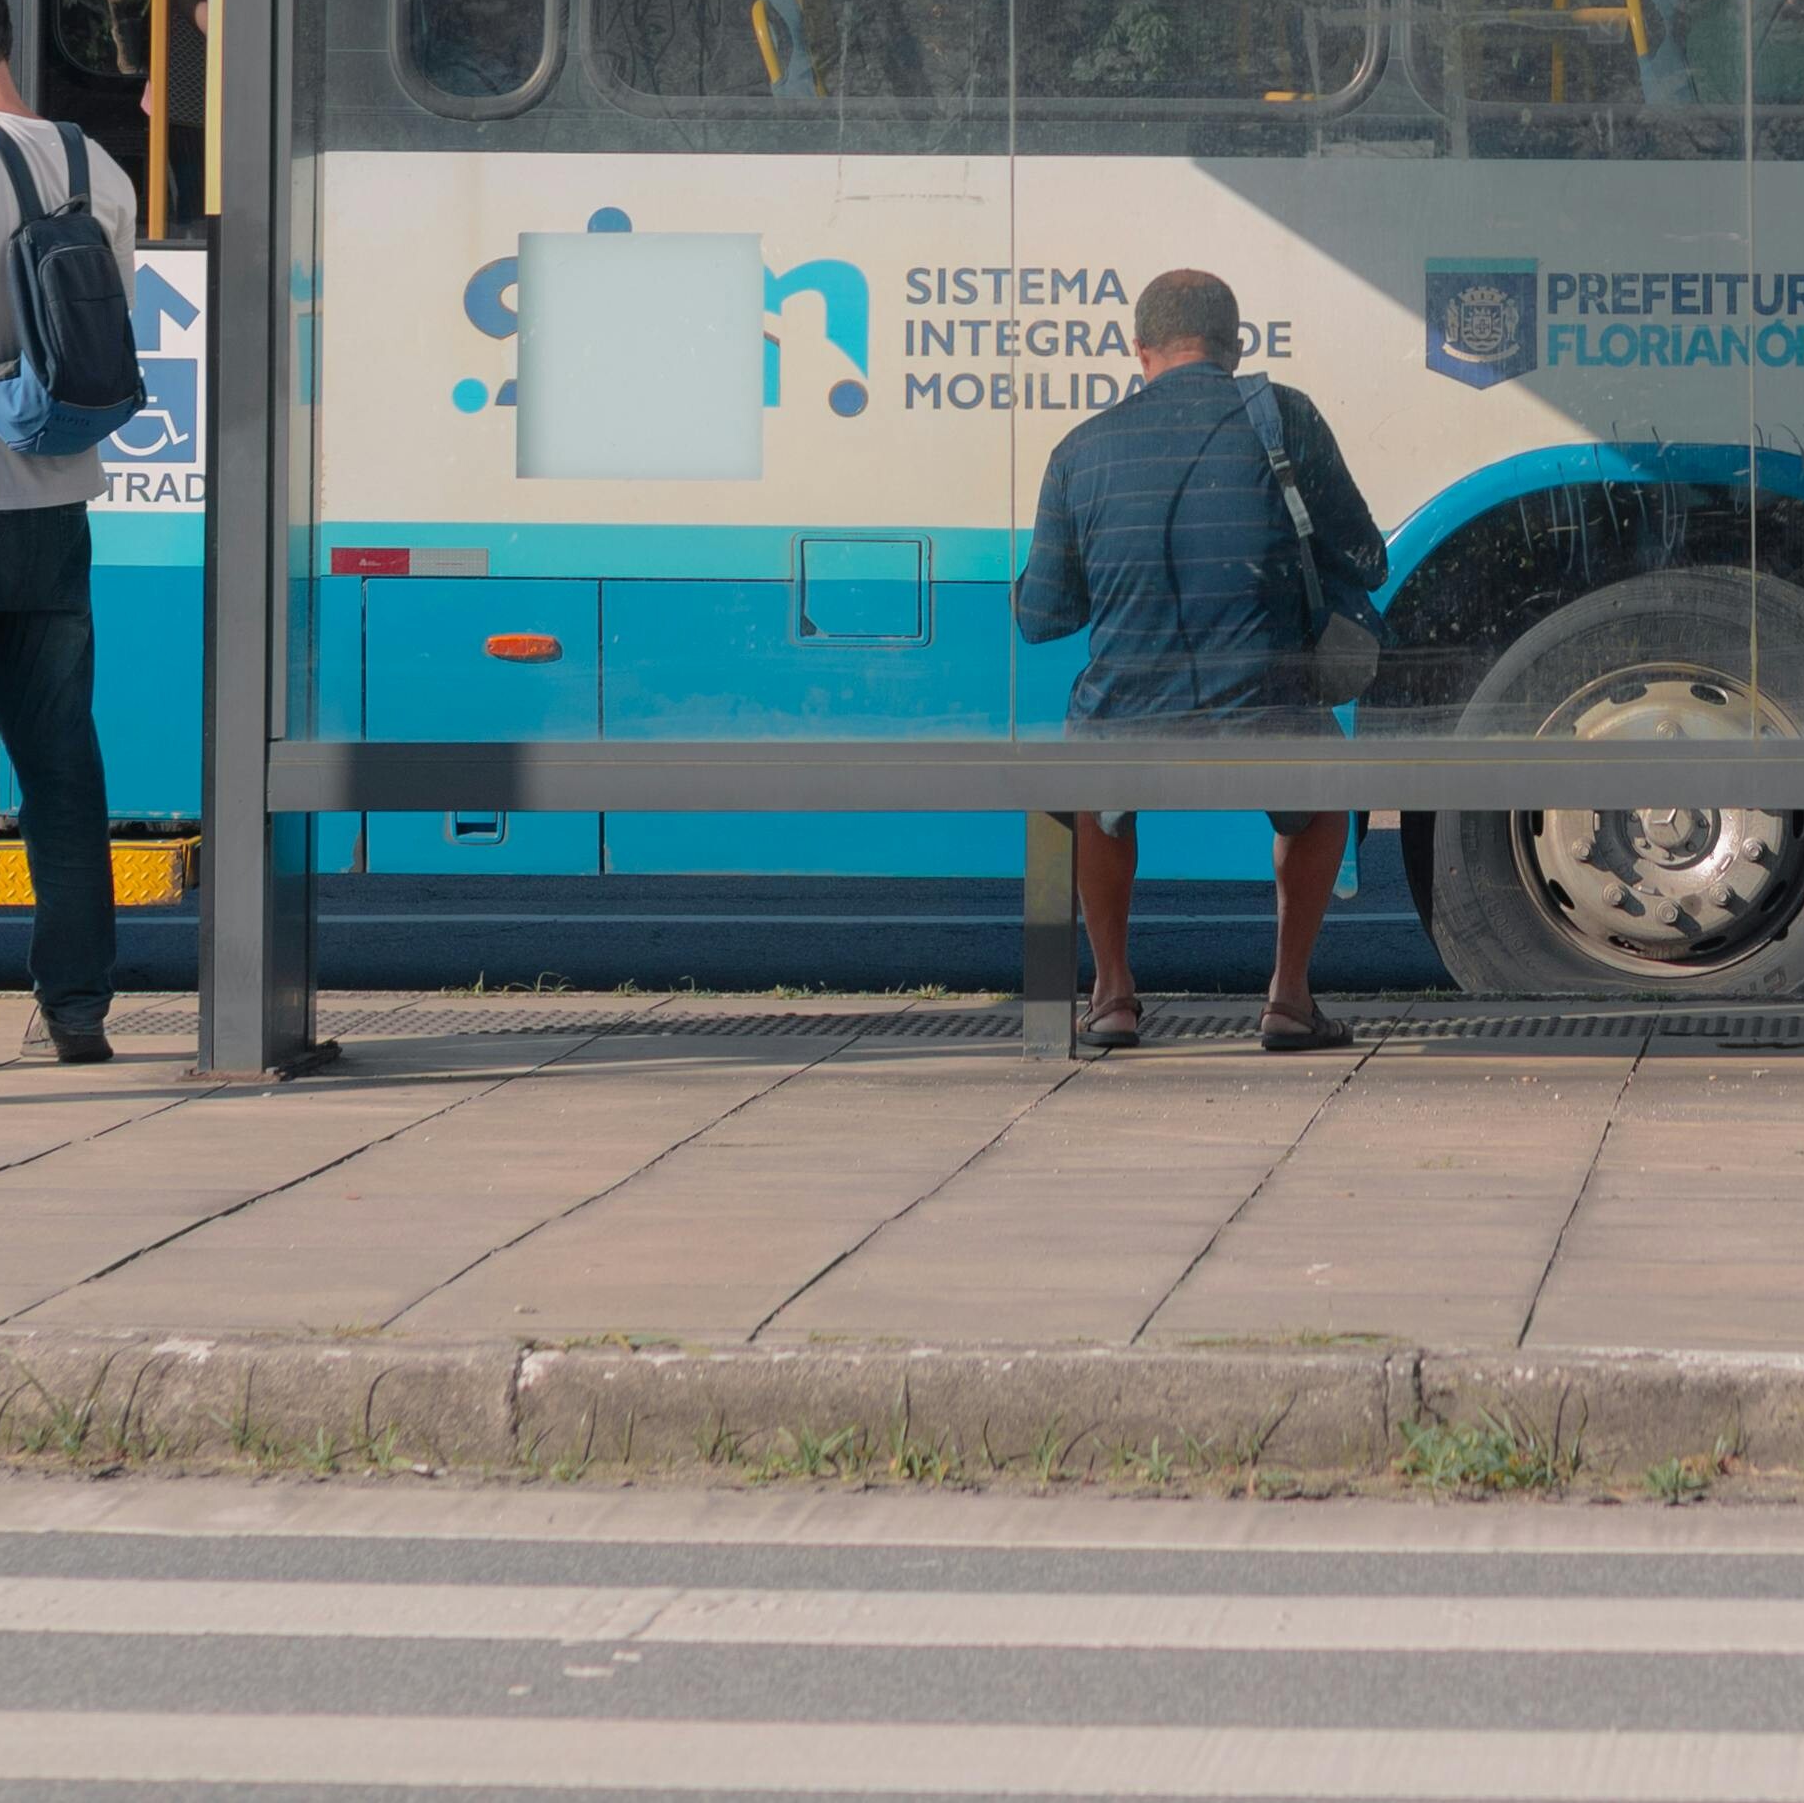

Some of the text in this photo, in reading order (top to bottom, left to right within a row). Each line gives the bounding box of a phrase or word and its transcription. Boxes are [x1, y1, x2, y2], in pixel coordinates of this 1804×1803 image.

[905, 267, 1129, 306] SISTEMA
[905, 319, 1138, 357] INTEGRA
[102, 472, 206, 503] TRAD
